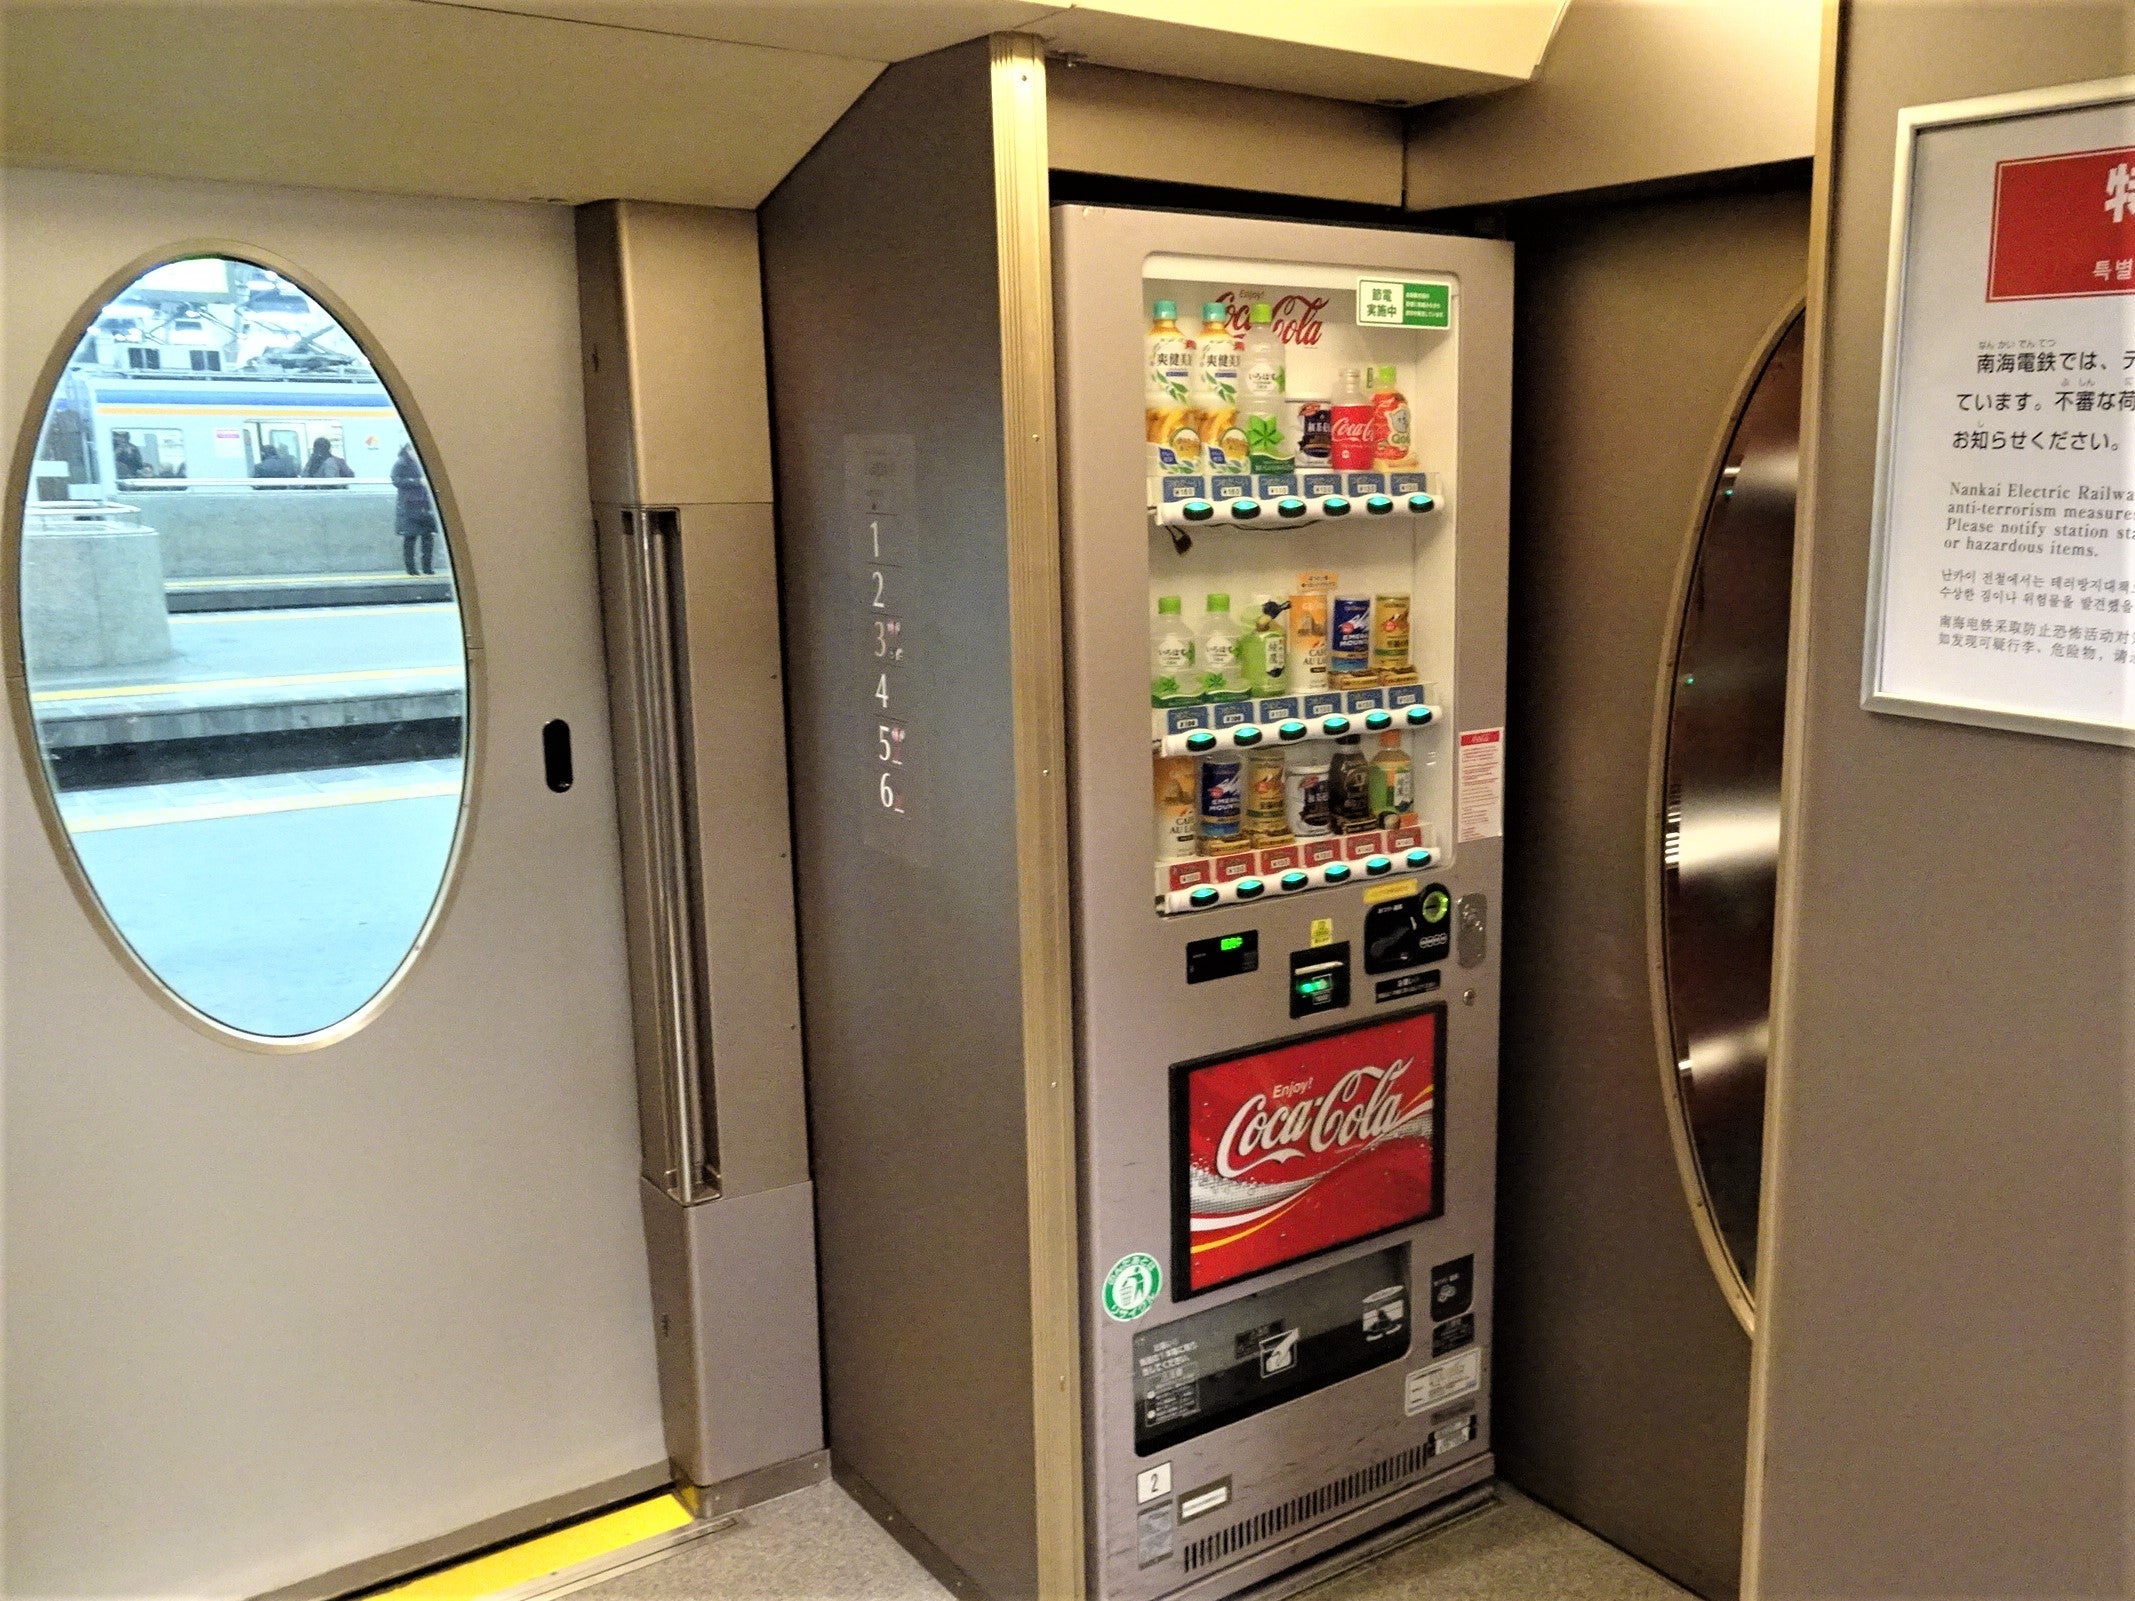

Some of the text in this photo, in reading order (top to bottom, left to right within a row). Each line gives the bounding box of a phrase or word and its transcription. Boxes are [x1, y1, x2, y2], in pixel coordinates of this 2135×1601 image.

[1952, 430, 2120, 451] お知らせください。
[1950, 482, 2000, 497] Nankai
[2007, 483, 2071, 499] Electric
[1947, 501, 2135, 521] anti-terrorism measure
[870, 521, 879, 557] 1
[1946, 517, 1994, 533] Please
[2001, 521, 2046, 538] notify
[2054, 523, 2109, 540] station
[1944, 537, 2099, 557] or hazardous items.
[872, 571, 885, 609] 2
[874, 621, 887, 657] 3
[875, 673, 889, 708] 4
[879, 725, 891, 761] 5
[880, 772, 894, 808] 6
[1273, 1077, 1314, 1100] Enjoy!
[1216, 1056, 1415, 1179] Coca-Cola
[1151, 1473, 1159, 1493] 2
